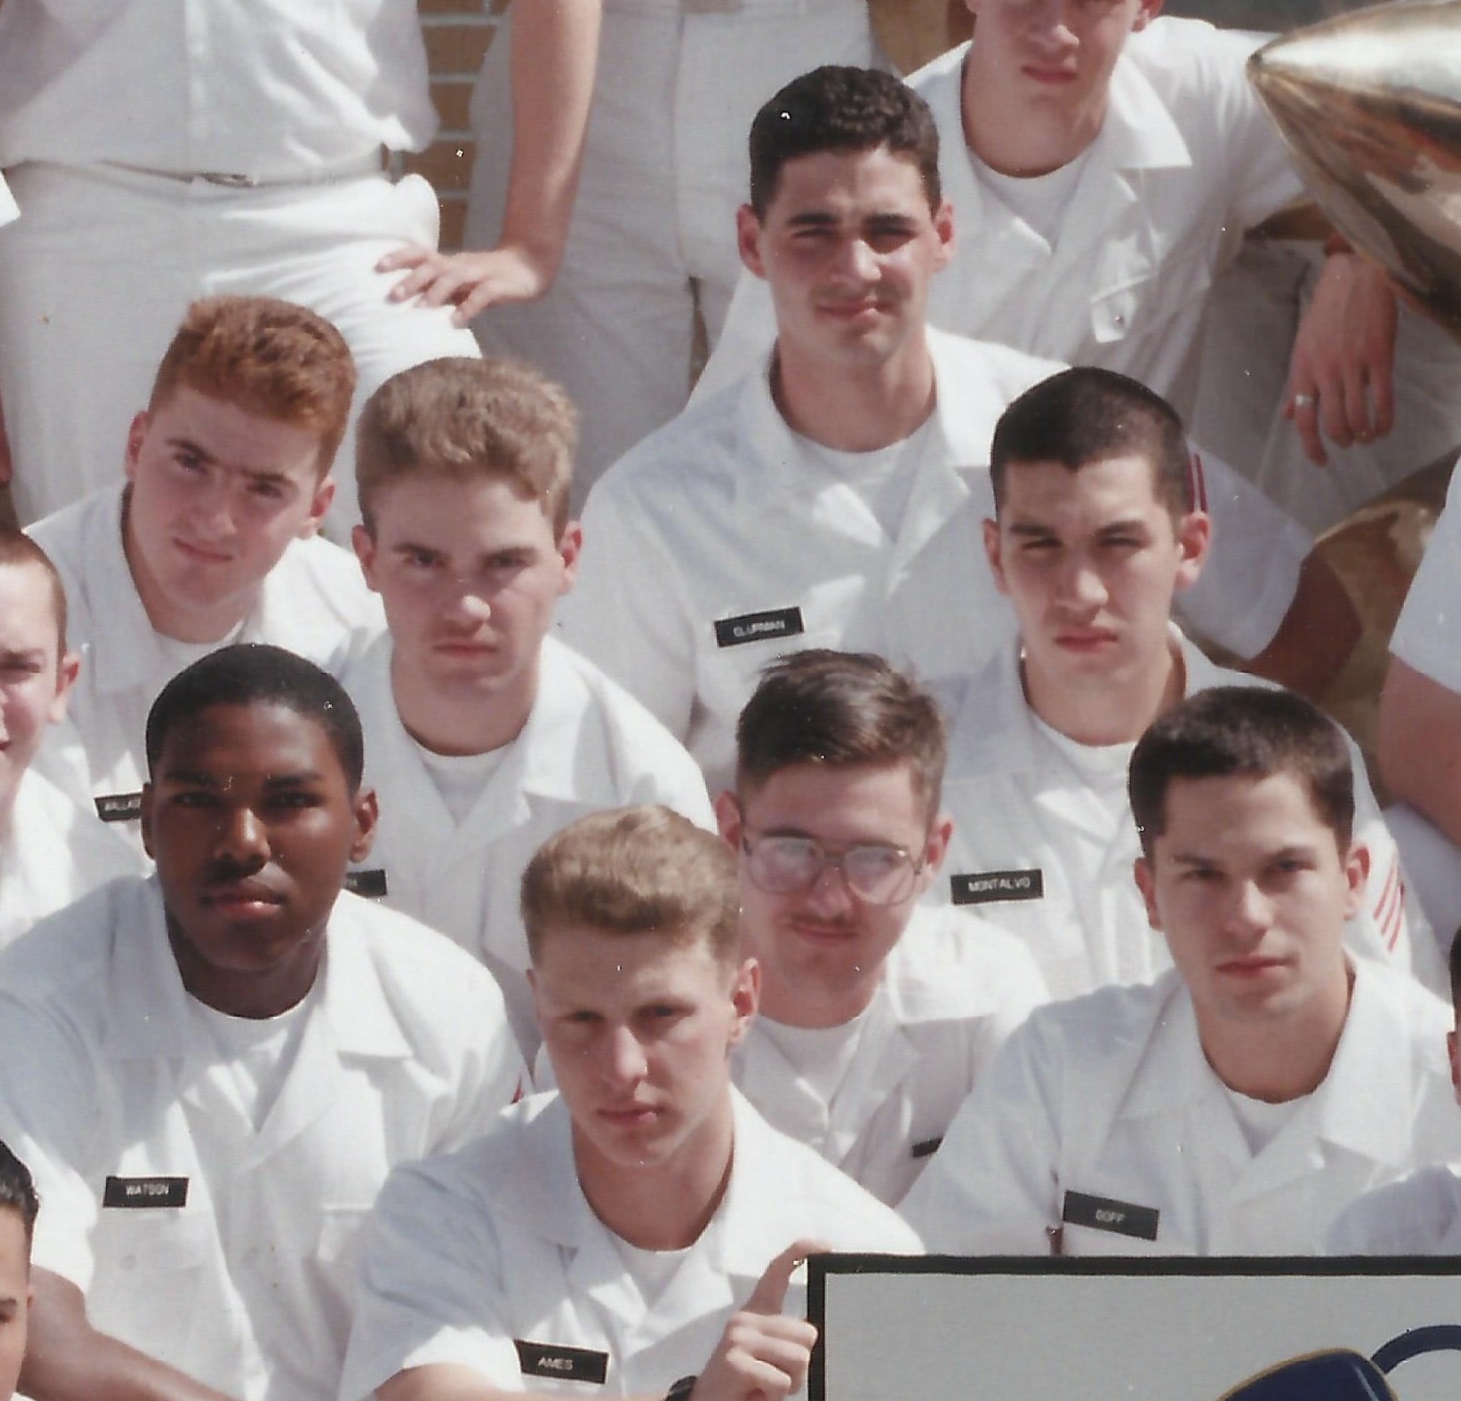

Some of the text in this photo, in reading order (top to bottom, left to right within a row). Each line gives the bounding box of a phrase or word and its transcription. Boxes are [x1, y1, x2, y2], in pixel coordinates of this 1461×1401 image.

[967, 877, 1031, 893] MONTALVO
[126, 1185, 170, 1196] WATSON
[537, 1357, 575, 1371] AMES
